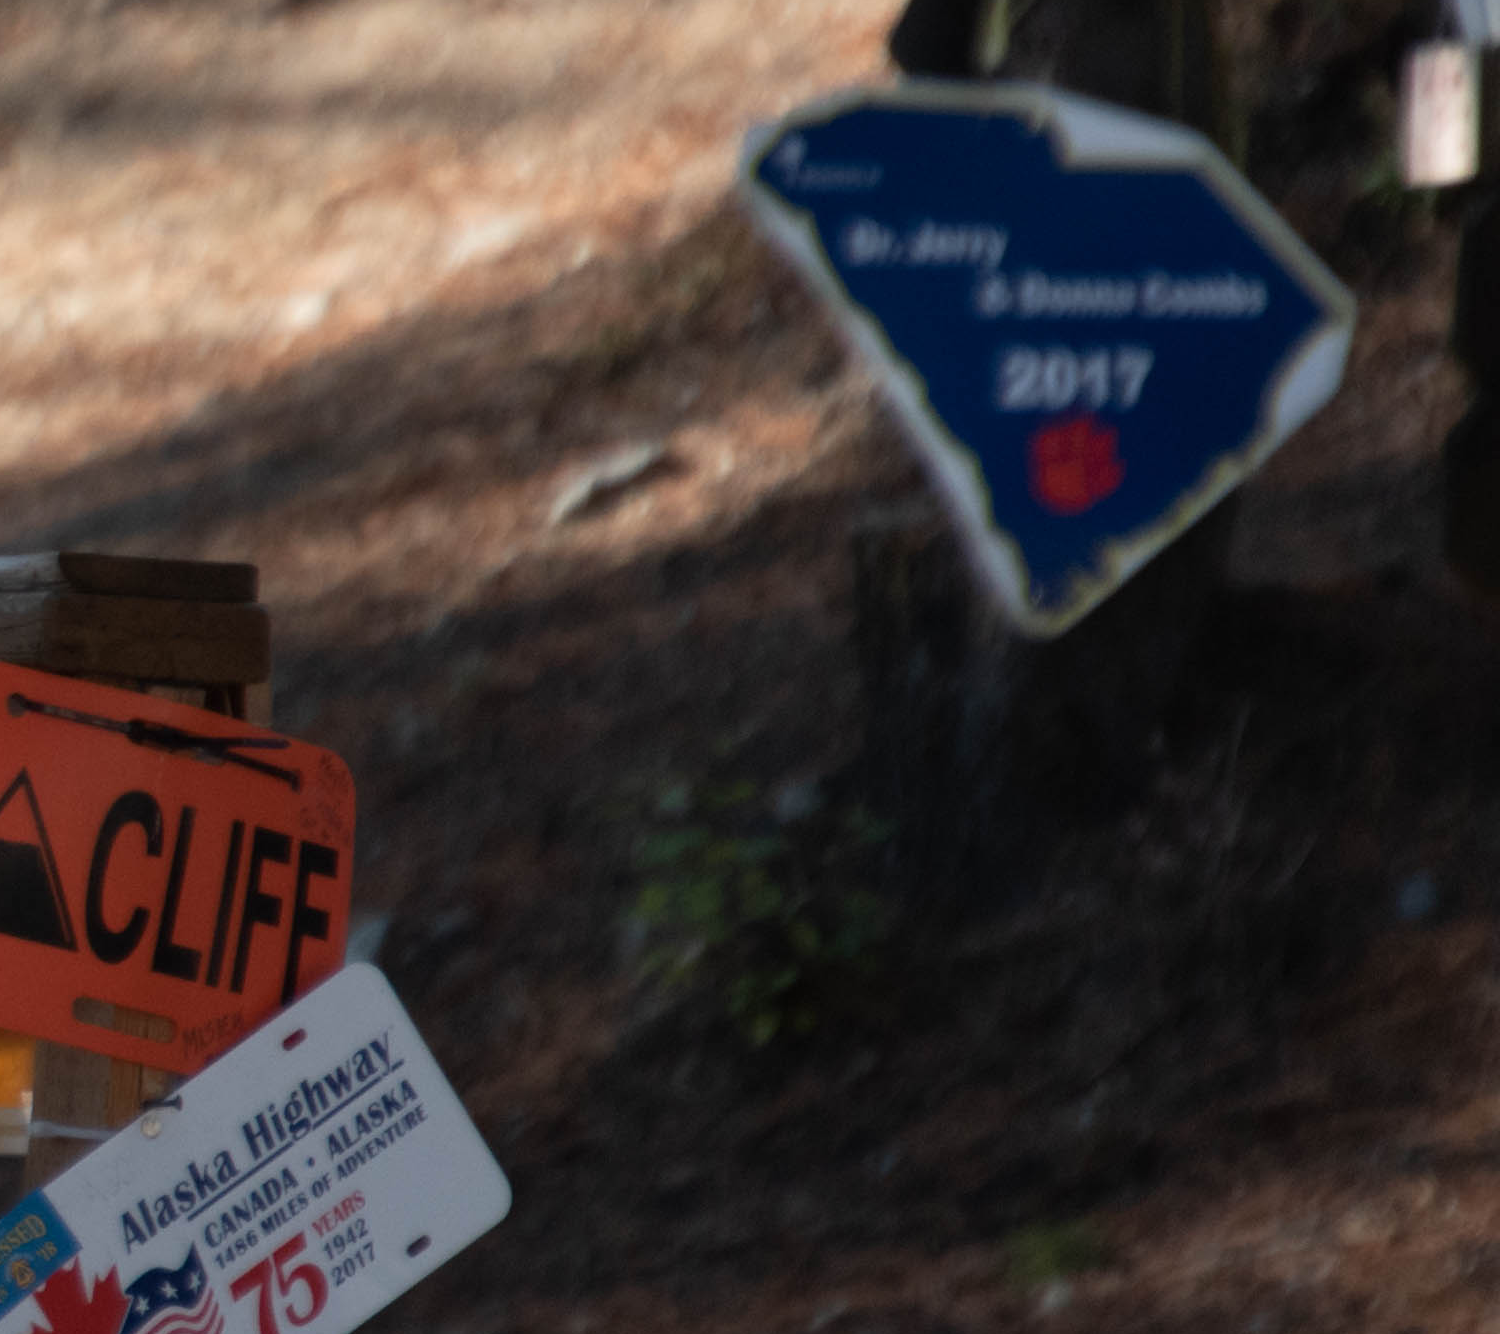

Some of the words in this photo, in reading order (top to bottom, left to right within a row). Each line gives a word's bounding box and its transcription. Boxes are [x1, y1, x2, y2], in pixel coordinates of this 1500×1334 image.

[996, 348, 1154, 412] 2017
[83, 789, 339, 1008] CLIFF
[120, 1149, 240, 1255] Alaska
[240, 1029, 396, 1160] Highway
[203, 1166, 300, 1249] CANADA
[325, 1078, 419, 1160] ALASKA
[214, 1236, 259, 1270] 1486
[259, 1196, 310, 1238] MILES
[311, 1170, 334, 1199] OF
[335, 1103, 430, 1183] ADVENTURE
[310, 1189, 367, 1239] YEARS
[321, 1217, 370, 1262] 1942
[330, 1241, 377, 1288] 2017
